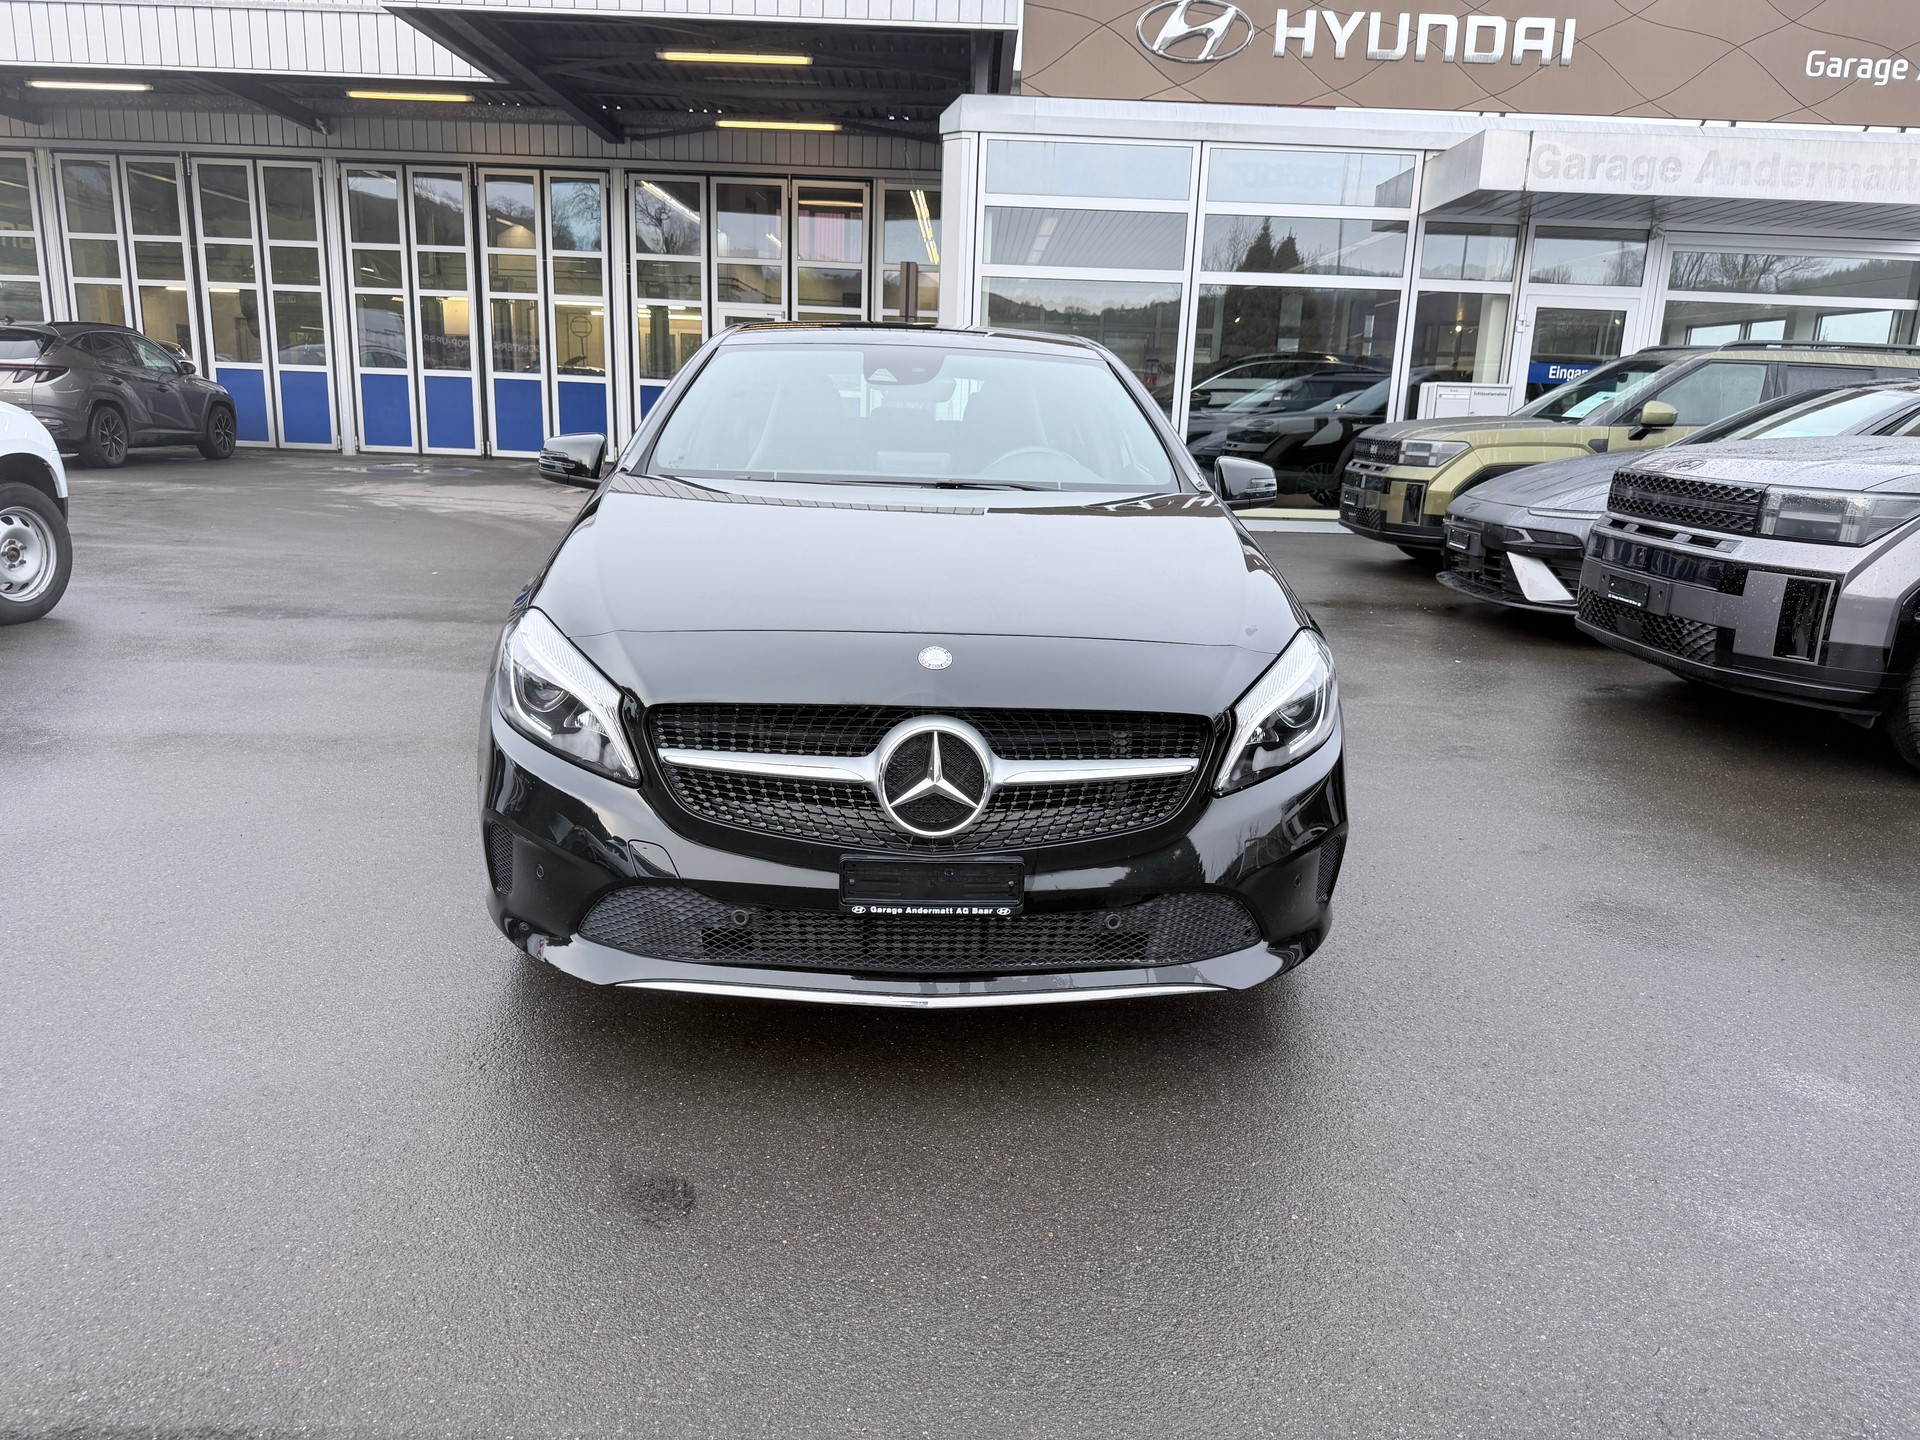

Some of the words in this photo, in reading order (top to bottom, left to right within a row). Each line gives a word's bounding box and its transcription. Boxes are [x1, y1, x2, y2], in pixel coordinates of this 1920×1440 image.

[1273, 8, 1577, 66] HYUNDAI
[1805, 49, 1909, 86] Garage
[1531, 143, 1683, 191] Garage
[1694, 150, 1920, 191] Andermatt
[870, 905, 903, 915] Garage
